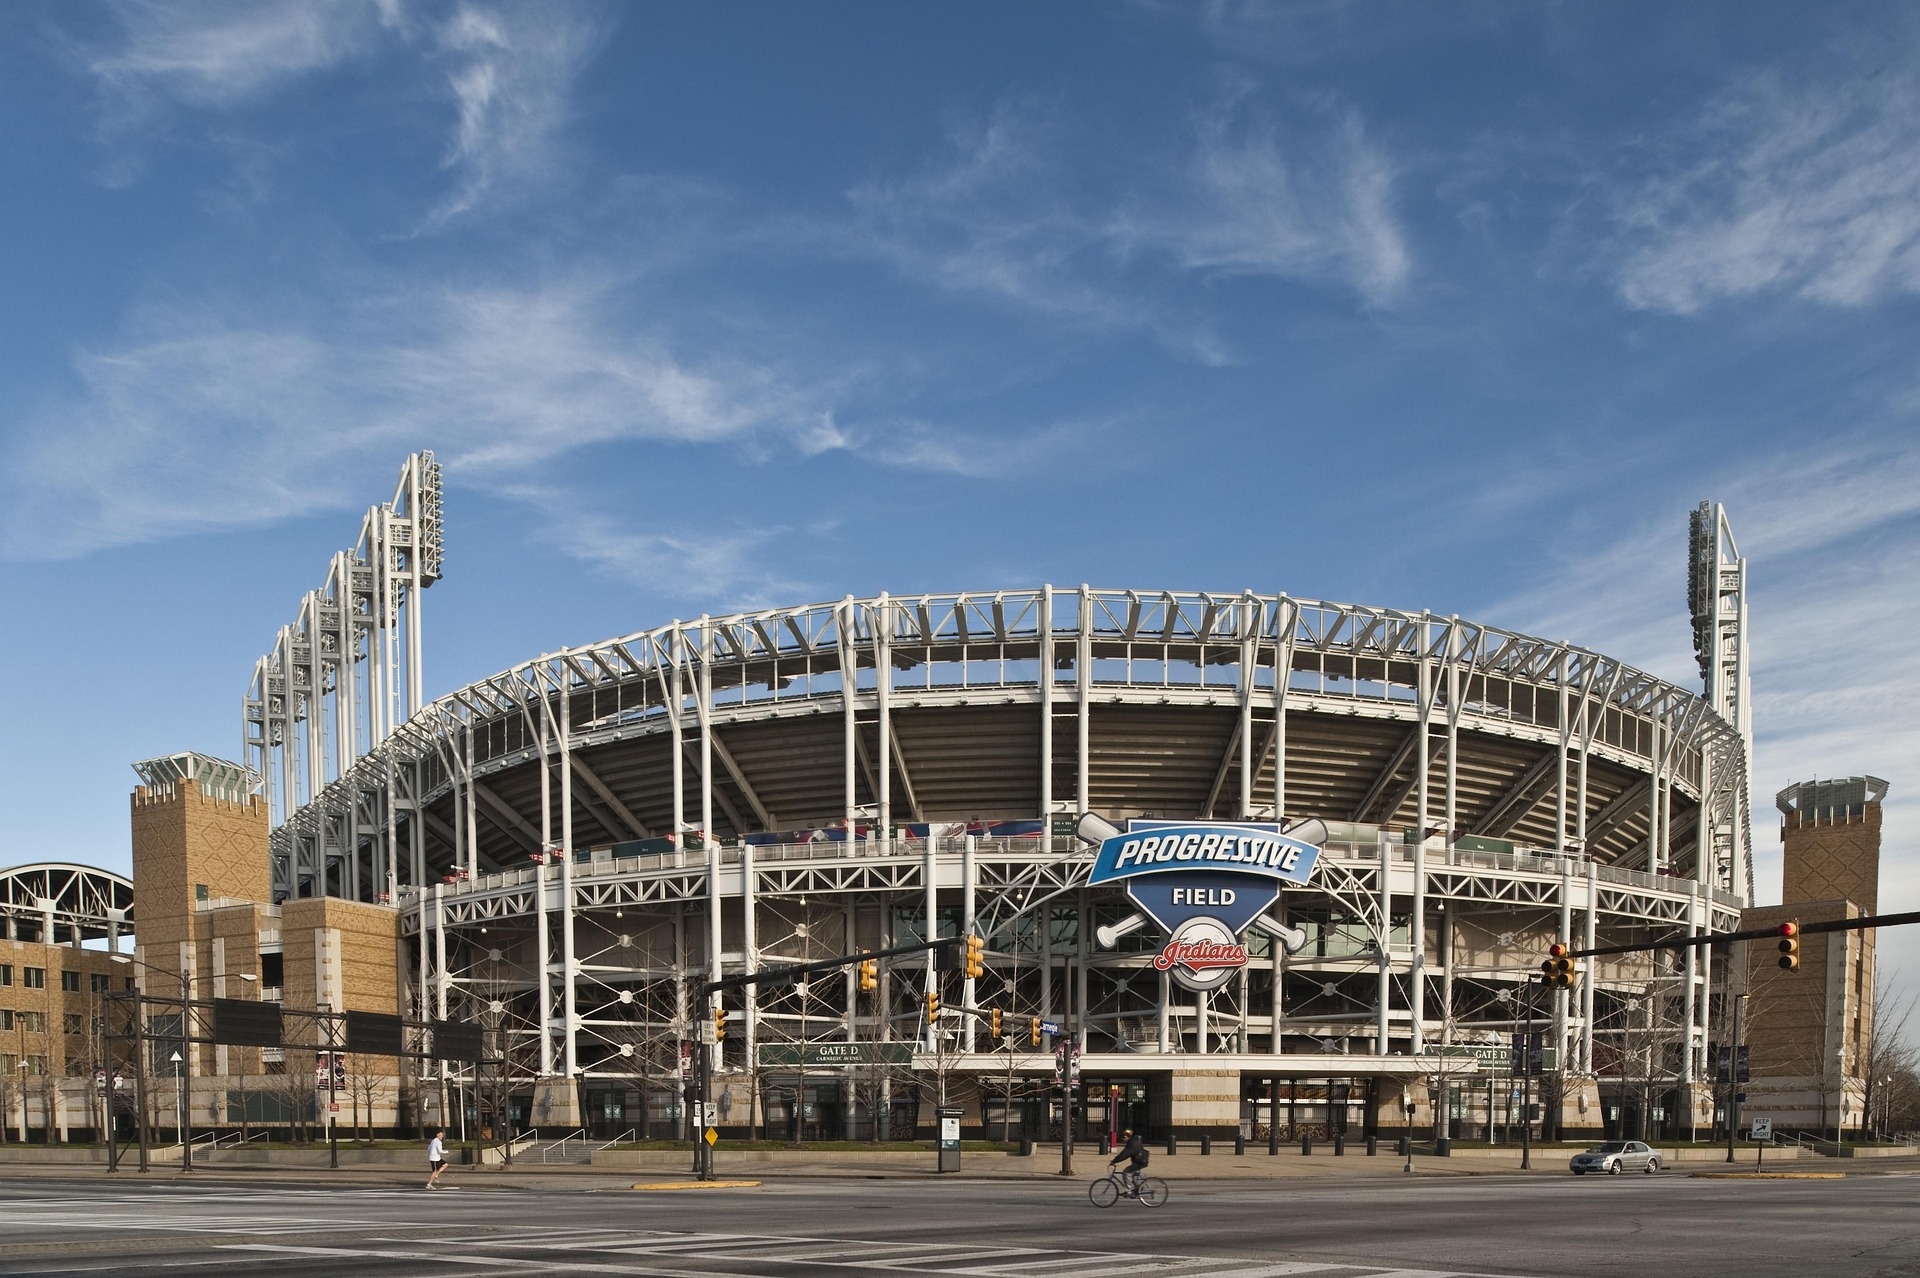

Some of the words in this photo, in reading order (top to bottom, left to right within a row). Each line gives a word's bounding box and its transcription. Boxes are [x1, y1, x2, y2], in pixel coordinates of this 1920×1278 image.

[1114, 834, 1303, 872] PROGRESSIVE
[1172, 888, 1236, 906] FIELD
[1153, 938, 1249, 974] Indians
[820, 1046, 846, 1055] GATE
[850, 1046, 858, 1055] D
[1476, 1050, 1498, 1059] GATE
[1500, 1050, 1507, 1059] D
